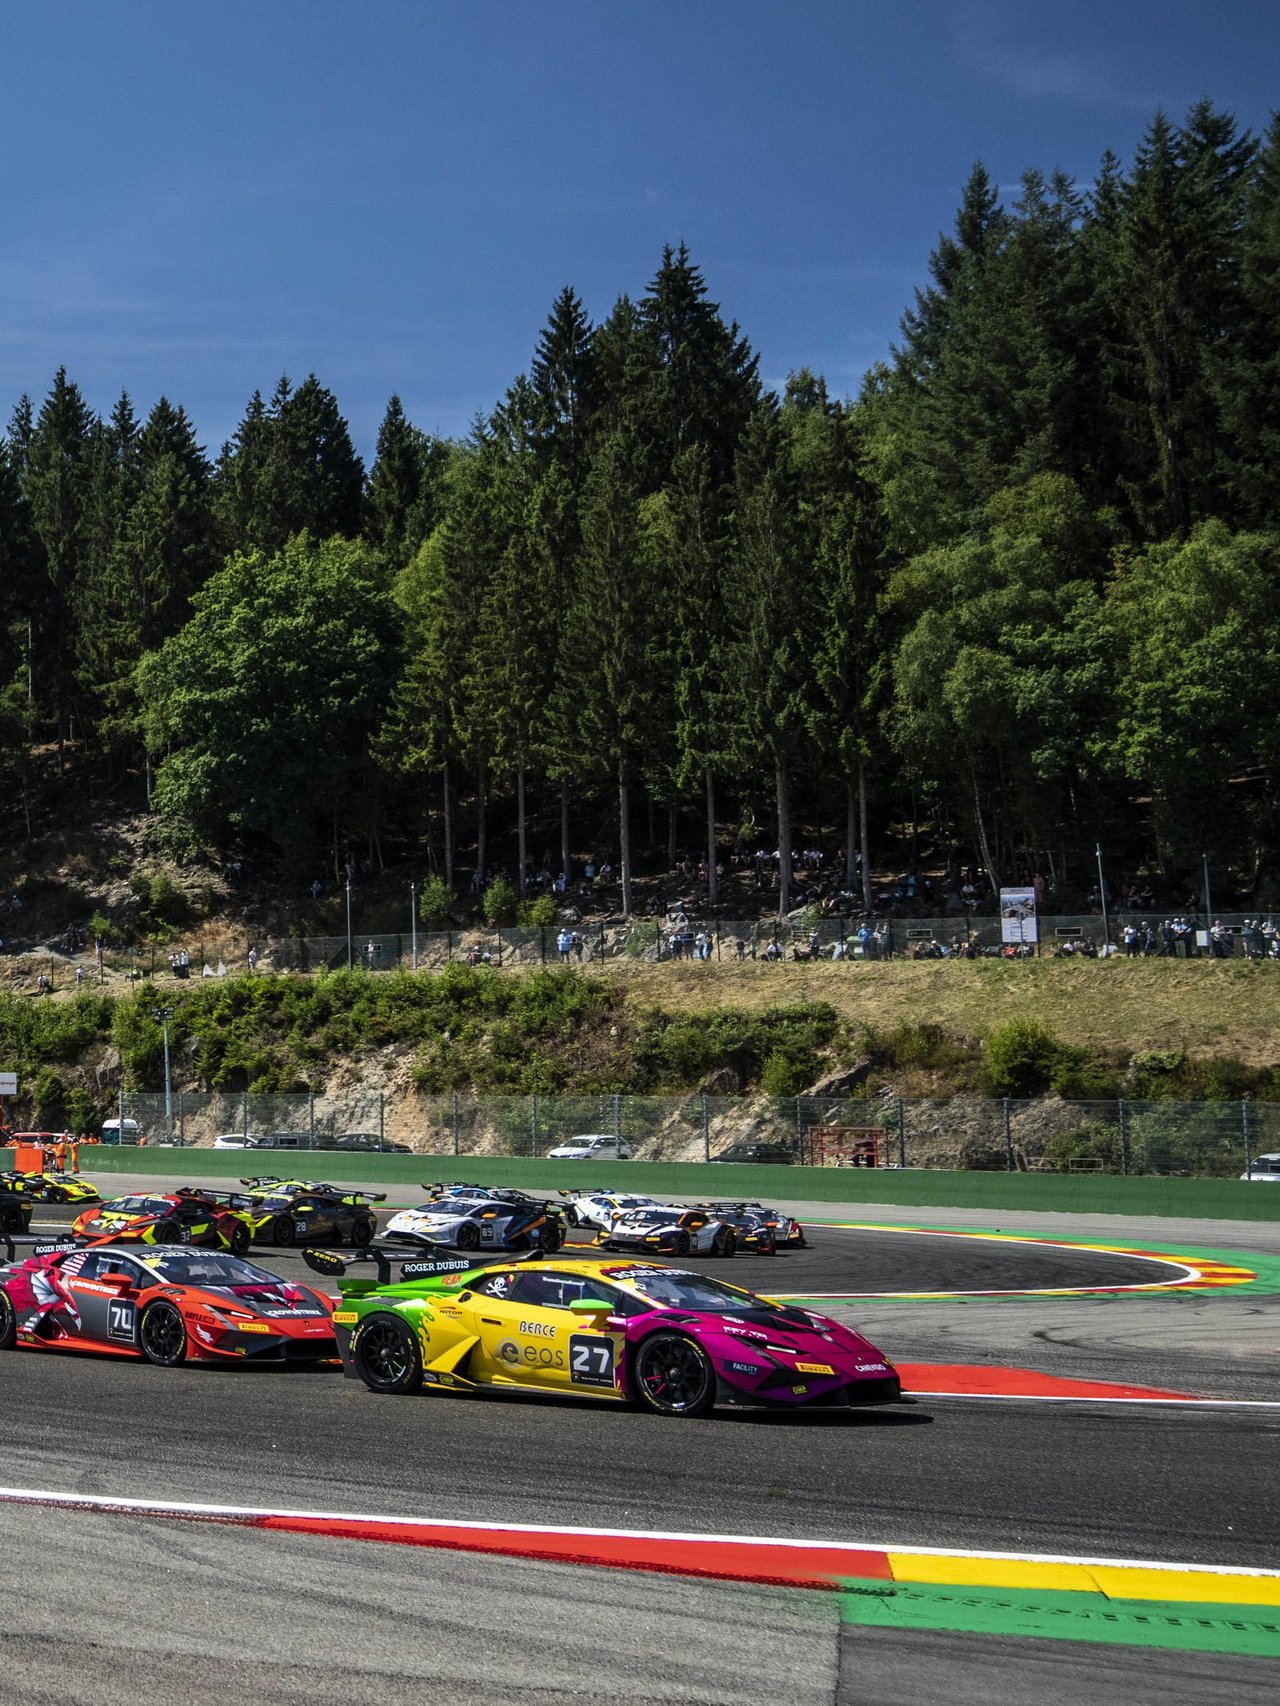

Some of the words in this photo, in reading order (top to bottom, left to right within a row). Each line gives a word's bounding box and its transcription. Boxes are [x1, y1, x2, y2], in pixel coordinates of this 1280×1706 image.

[296, 1222, 307, 1232] 28
[482, 1227, 493, 1237] 89
[35, 1244, 55, 1254] ROGER
[313, 1251, 338, 1263] ZERO
[404, 1261, 435, 1273] ROGER
[436, 1259, 470, 1271] DUBUIS
[111, 1307, 132, 1329] 70
[334, 1313, 357, 1322] PIRELLI
[523, 1345, 564, 1367] eos
[572, 1344, 610, 1374] 27
[732, 1362, 759, 1373] FACILITY
[800, 1364, 830, 1373] PIRELLI
